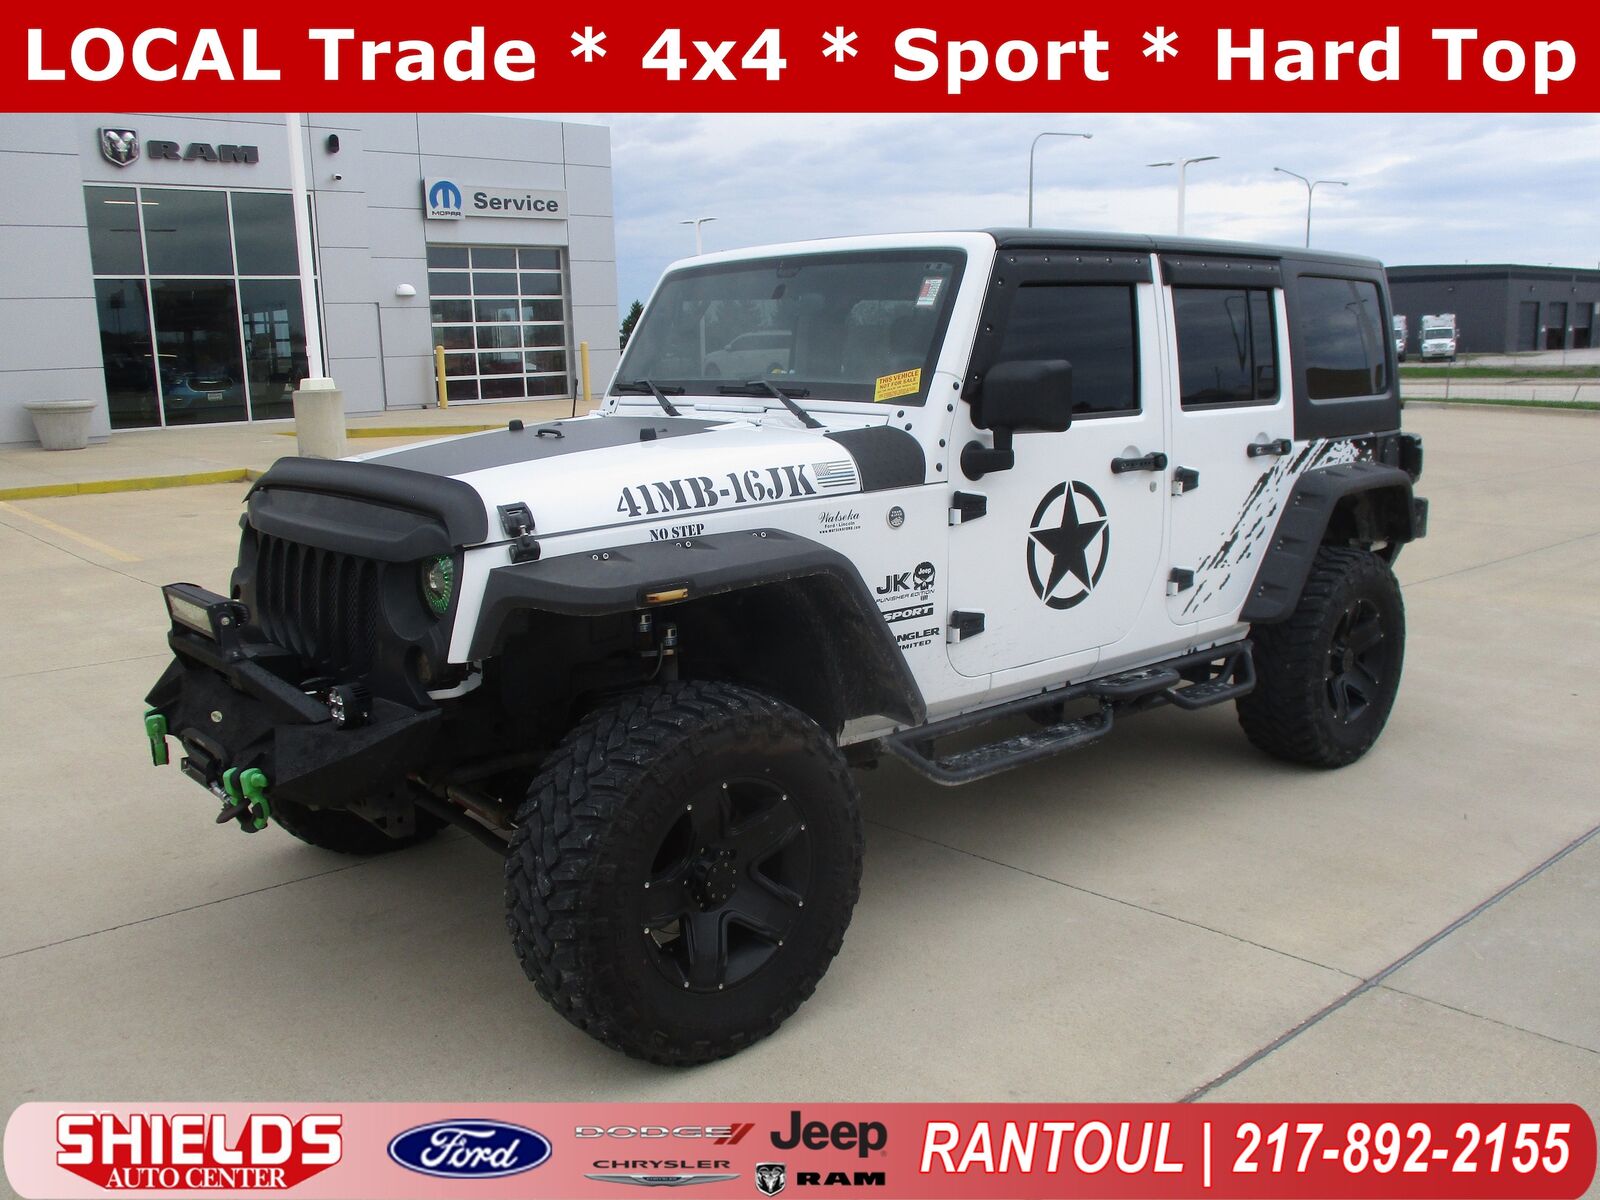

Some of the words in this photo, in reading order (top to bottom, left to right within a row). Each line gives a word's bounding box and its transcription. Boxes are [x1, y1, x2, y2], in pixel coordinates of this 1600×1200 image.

[147, 140, 259, 164] RAM
[473, 191, 559, 213] Service
[893, 371, 918, 380] VEHICLE
[616, 463, 817, 518] 41MB-16JK
[818, 508, 861, 523] Watseka
[650, 527, 669, 541] NO
[671, 523, 705, 539] STEP
[918, 567, 932, 575] Jeep
[876, 571, 912, 595] JK
[876, 593, 910, 603] PUNISHER
[910, 589, 936, 598] EDITION
[883, 606, 931, 622] SPORT
[895, 627, 940, 643] NGLER
